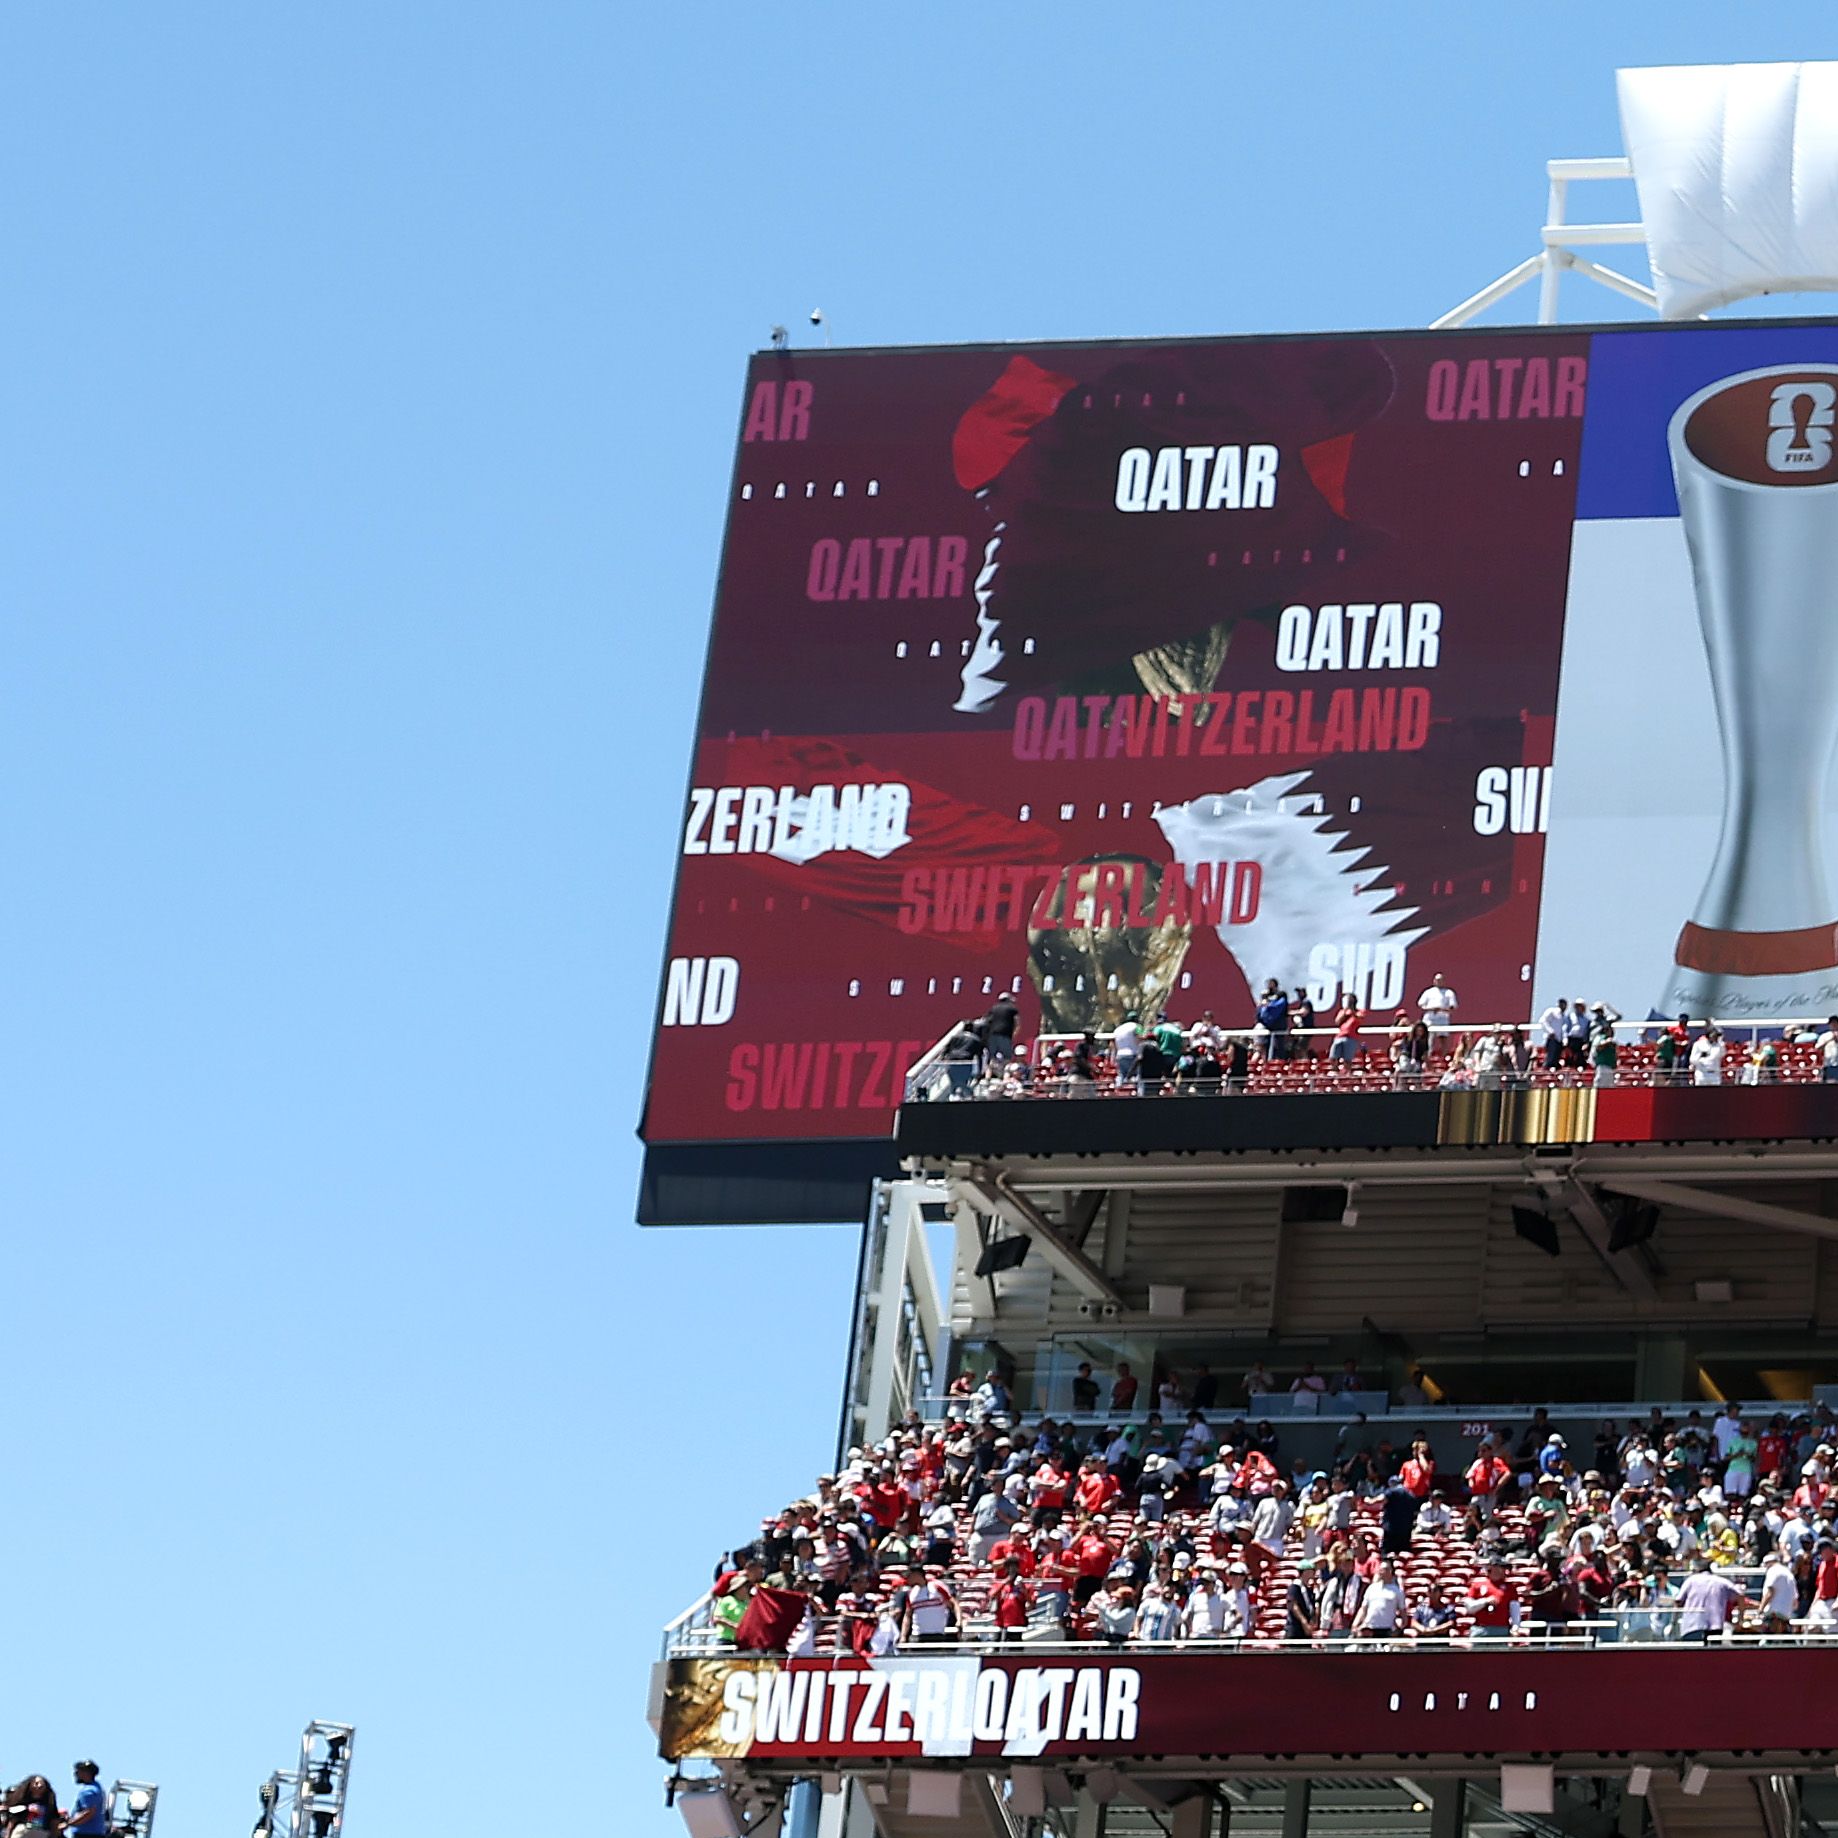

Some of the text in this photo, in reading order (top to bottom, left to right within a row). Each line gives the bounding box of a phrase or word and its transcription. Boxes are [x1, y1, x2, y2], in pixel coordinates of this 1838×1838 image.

[742, 380, 815, 442] AR
[1425, 356, 1587, 421] QATAR
[1115, 443, 1280, 512] QATAR
[1785, 450, 1813, 463] FIFA
[806, 535, 969, 601] QATAR
[1275, 602, 1443, 672] QATAR
[683, 782, 911, 856] ZERLAND
[898, 860, 1263, 936] SWITZERLAND
[662, 956, 741, 1027] ND
[1463, 1423, 1489, 1437] 201
